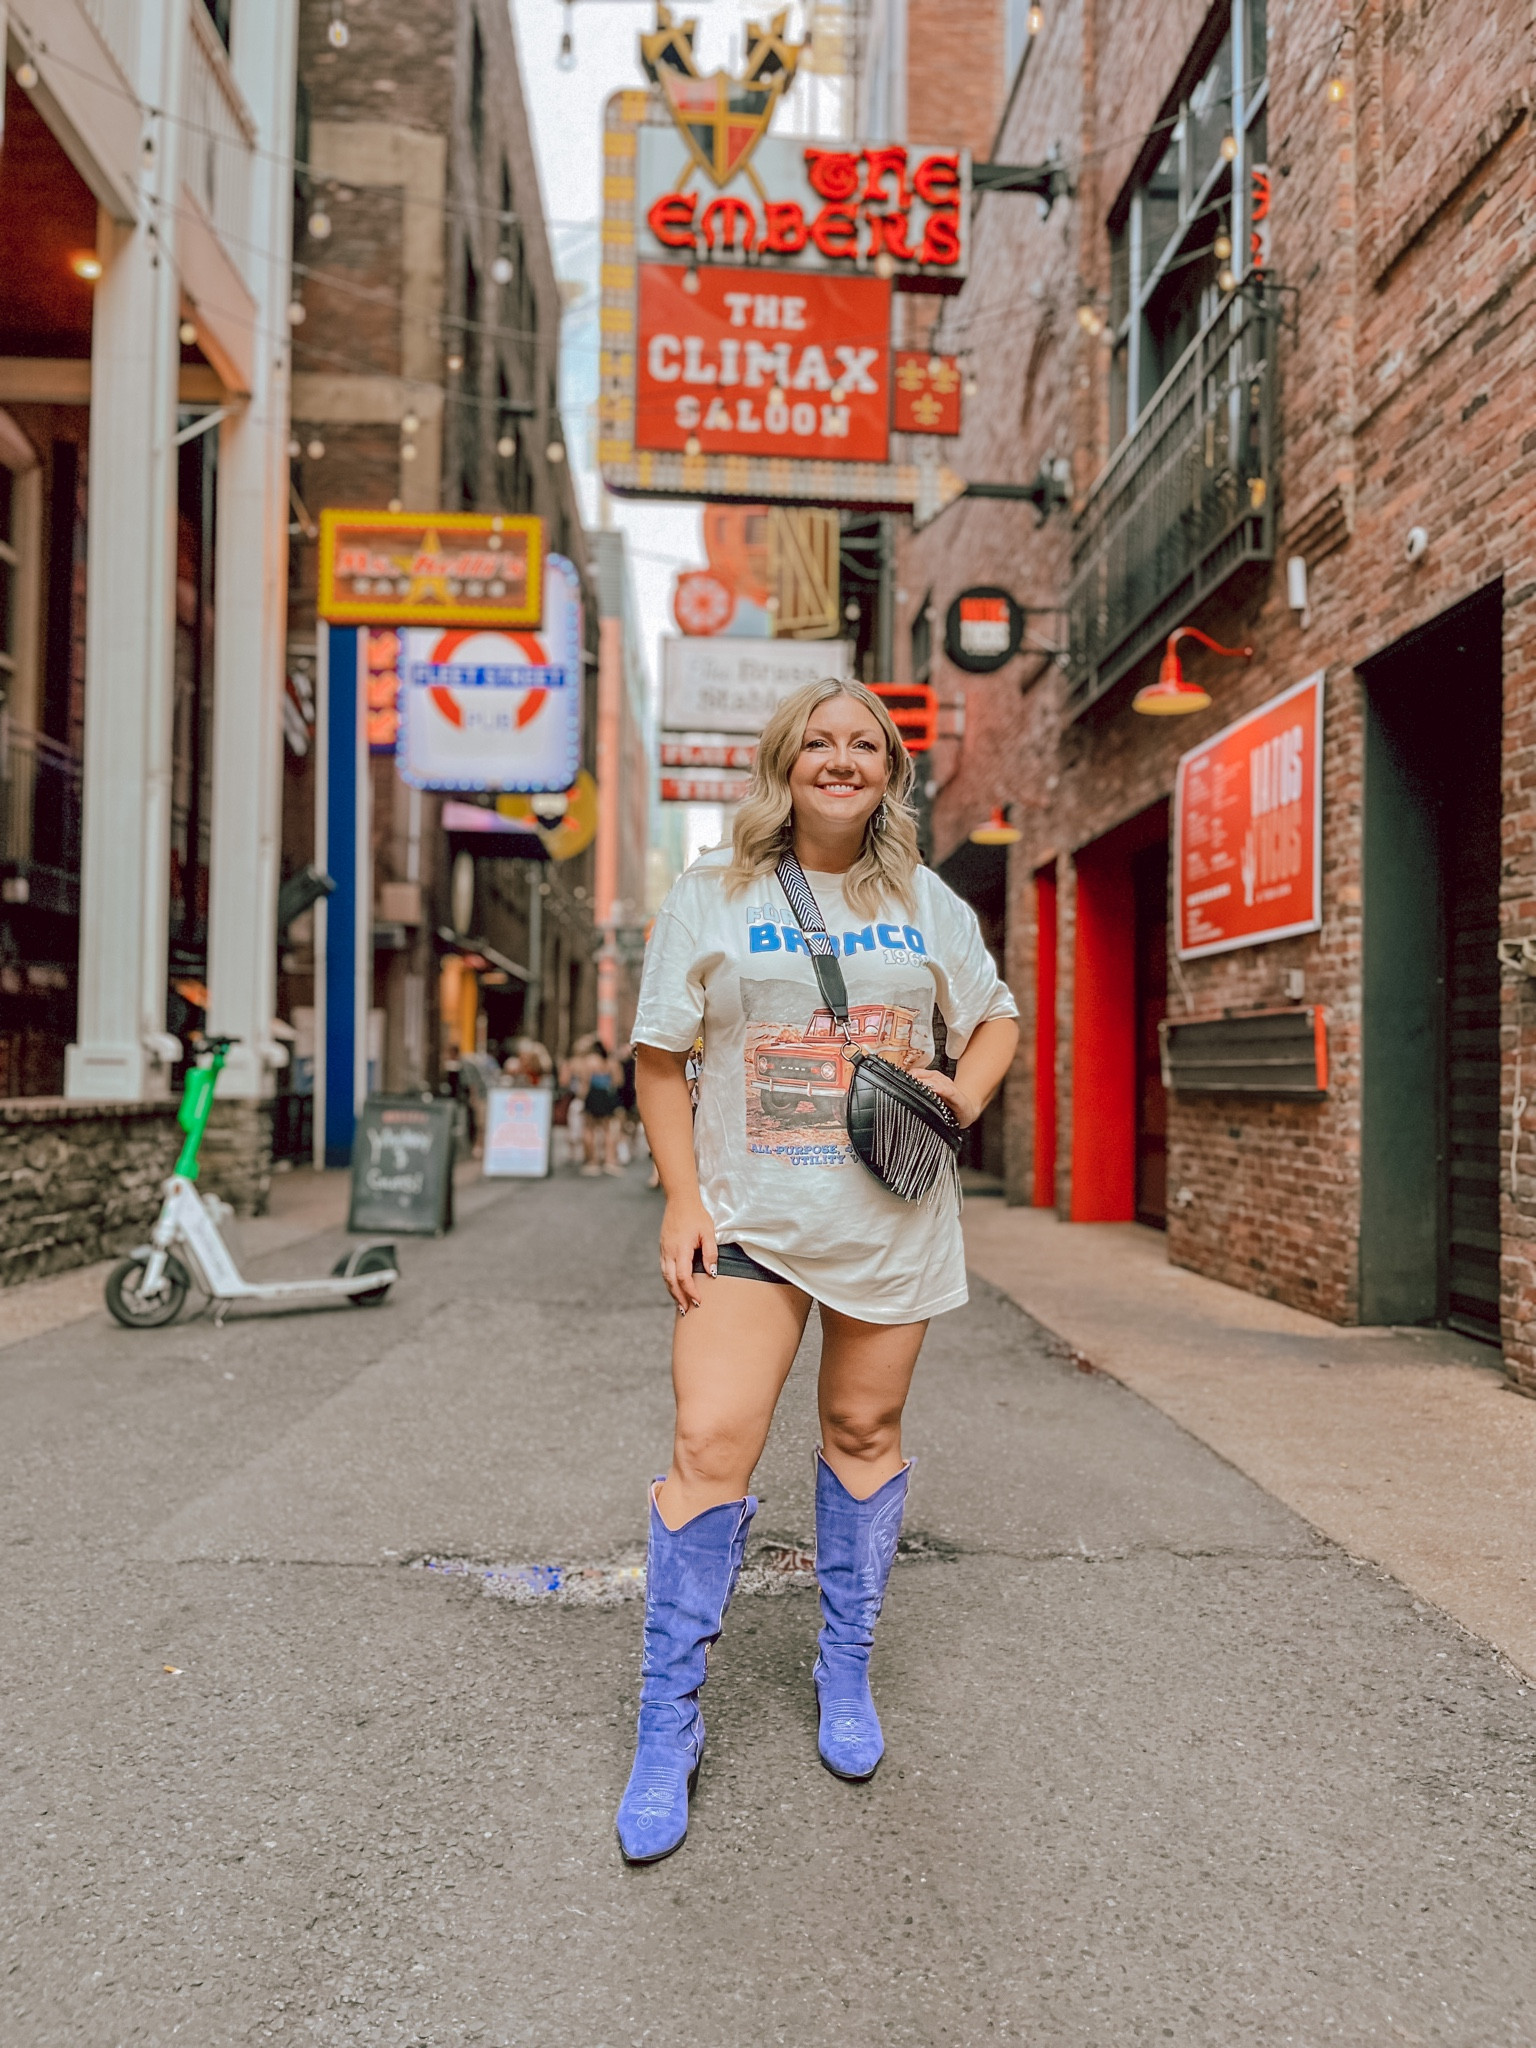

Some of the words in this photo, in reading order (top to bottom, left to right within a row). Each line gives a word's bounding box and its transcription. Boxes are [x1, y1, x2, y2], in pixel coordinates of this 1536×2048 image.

[723, 293, 807, 330] THE
[648, 334, 879, 394] CLIMAX
[674, 396, 851, 438] SALOON
[746, 902, 801, 928] FOR
[790, 1154, 846, 1166] UTILITY
